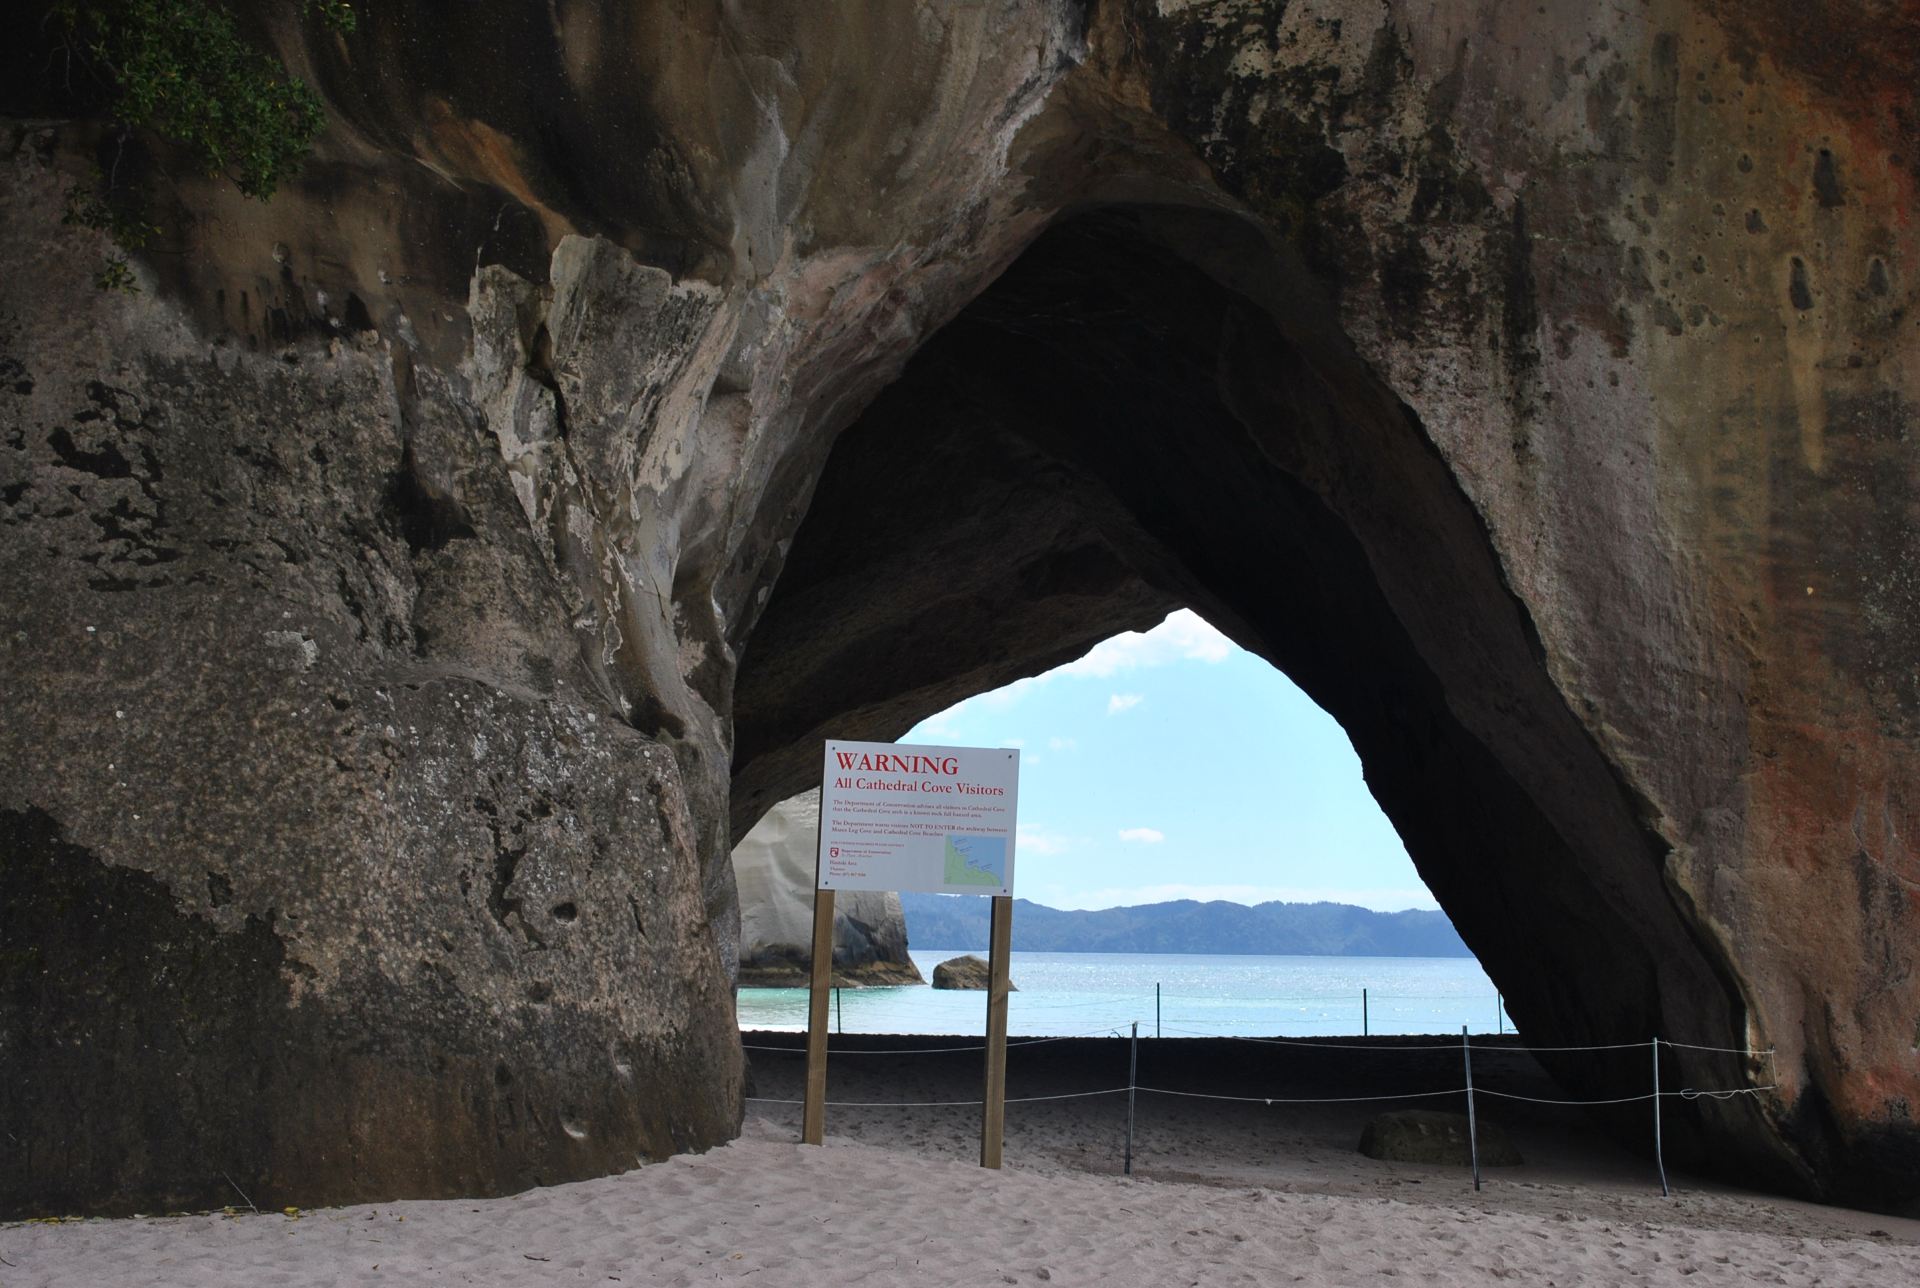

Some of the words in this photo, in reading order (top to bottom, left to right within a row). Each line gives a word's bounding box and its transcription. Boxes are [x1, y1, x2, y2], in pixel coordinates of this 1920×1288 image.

[836, 752, 959, 775] WARNING
[835, 777, 852, 788] All
[856, 778, 918, 792] Cathedral
[922, 781, 952, 793] Cove
[957, 782, 1004, 796] Visitors
